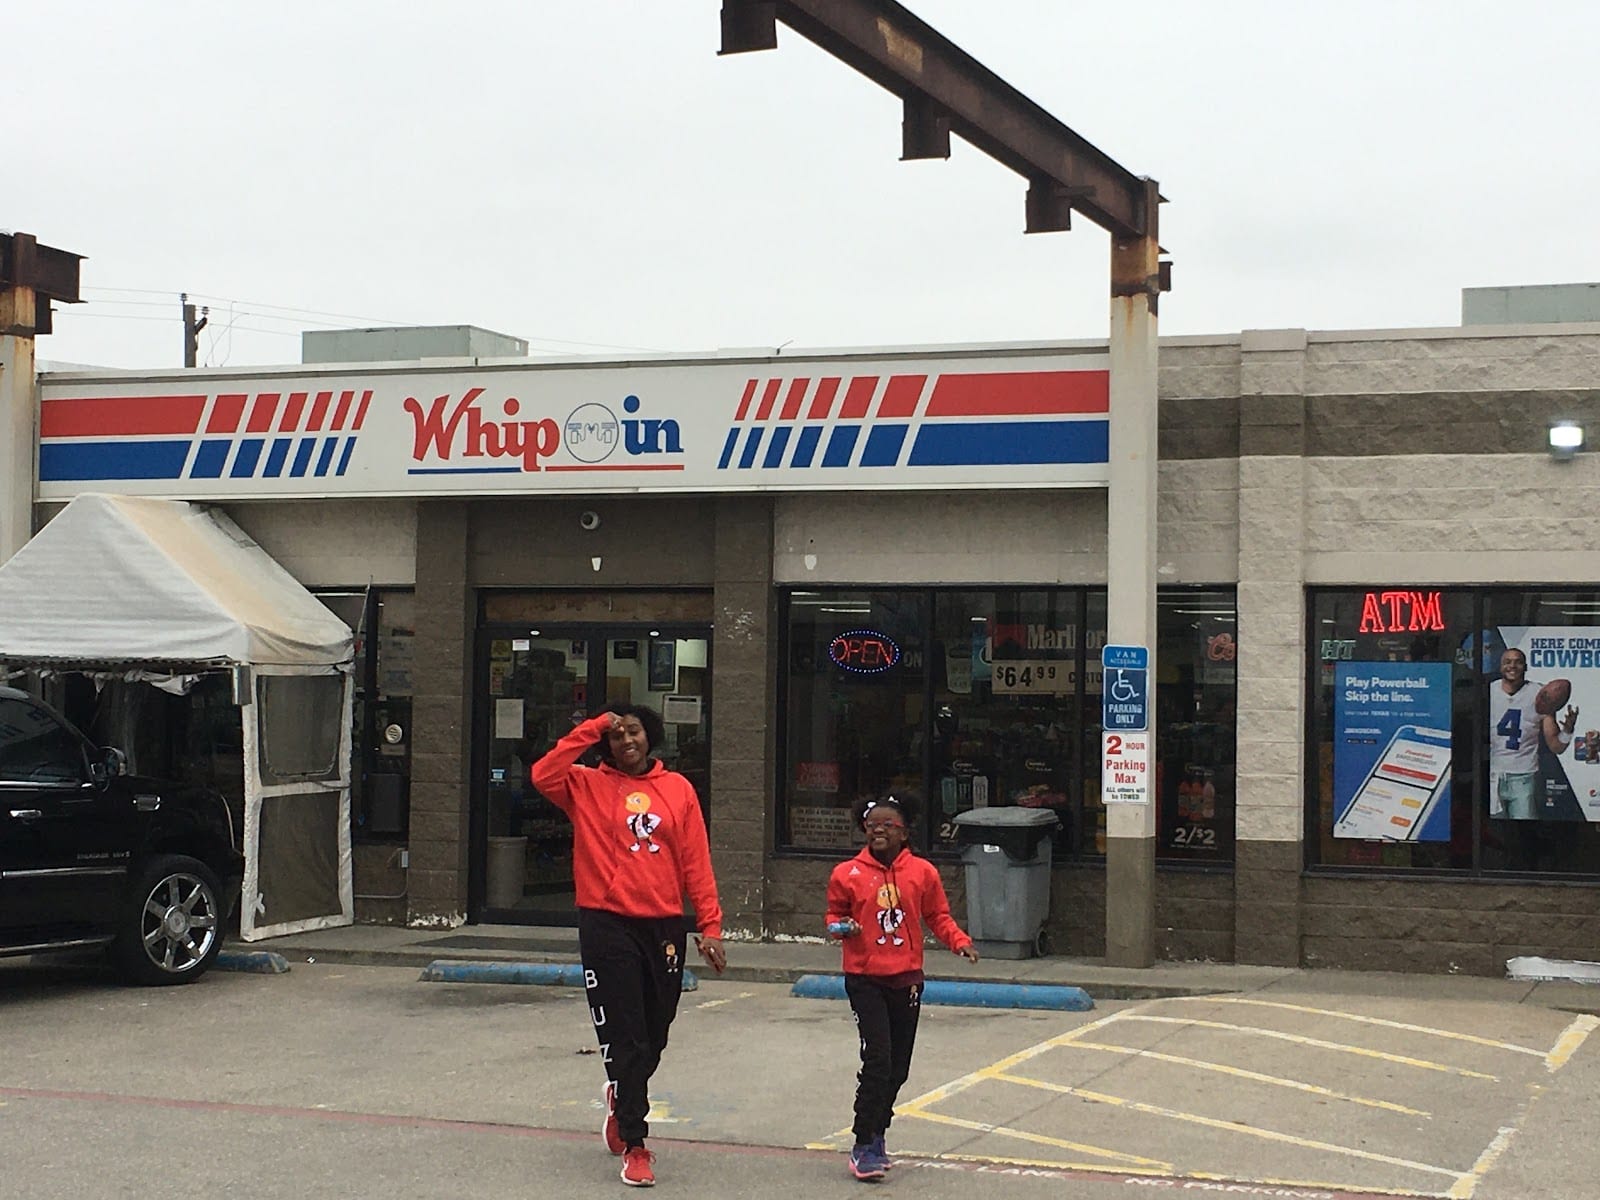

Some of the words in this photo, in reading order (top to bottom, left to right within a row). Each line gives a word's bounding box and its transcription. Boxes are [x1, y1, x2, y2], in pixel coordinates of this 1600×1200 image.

[403, 388, 560, 472] Whip
[621, 395, 684, 455] in
[1359, 591, 1445, 633] ATM
[1028, 624, 1106, 649] Marlor
[1530, 638, 1565, 649] HERE
[832, 638, 894, 665] OPEN
[1115, 650, 1137, 659] VAN
[1345, 677, 1369, 689] Play
[1345, 691, 1369, 704] Skip
[1371, 692, 1389, 702] the
[1108, 703, 1143, 714] PARKING
[1115, 713, 1135, 724] ONLY
[1496, 708, 1522, 751] 4
[1106, 735, 1122, 755] 2
[1125, 742, 1146, 750] HOUR
[1106, 759, 1146, 773] Parking
[1114, 773, 1137, 784] Max
